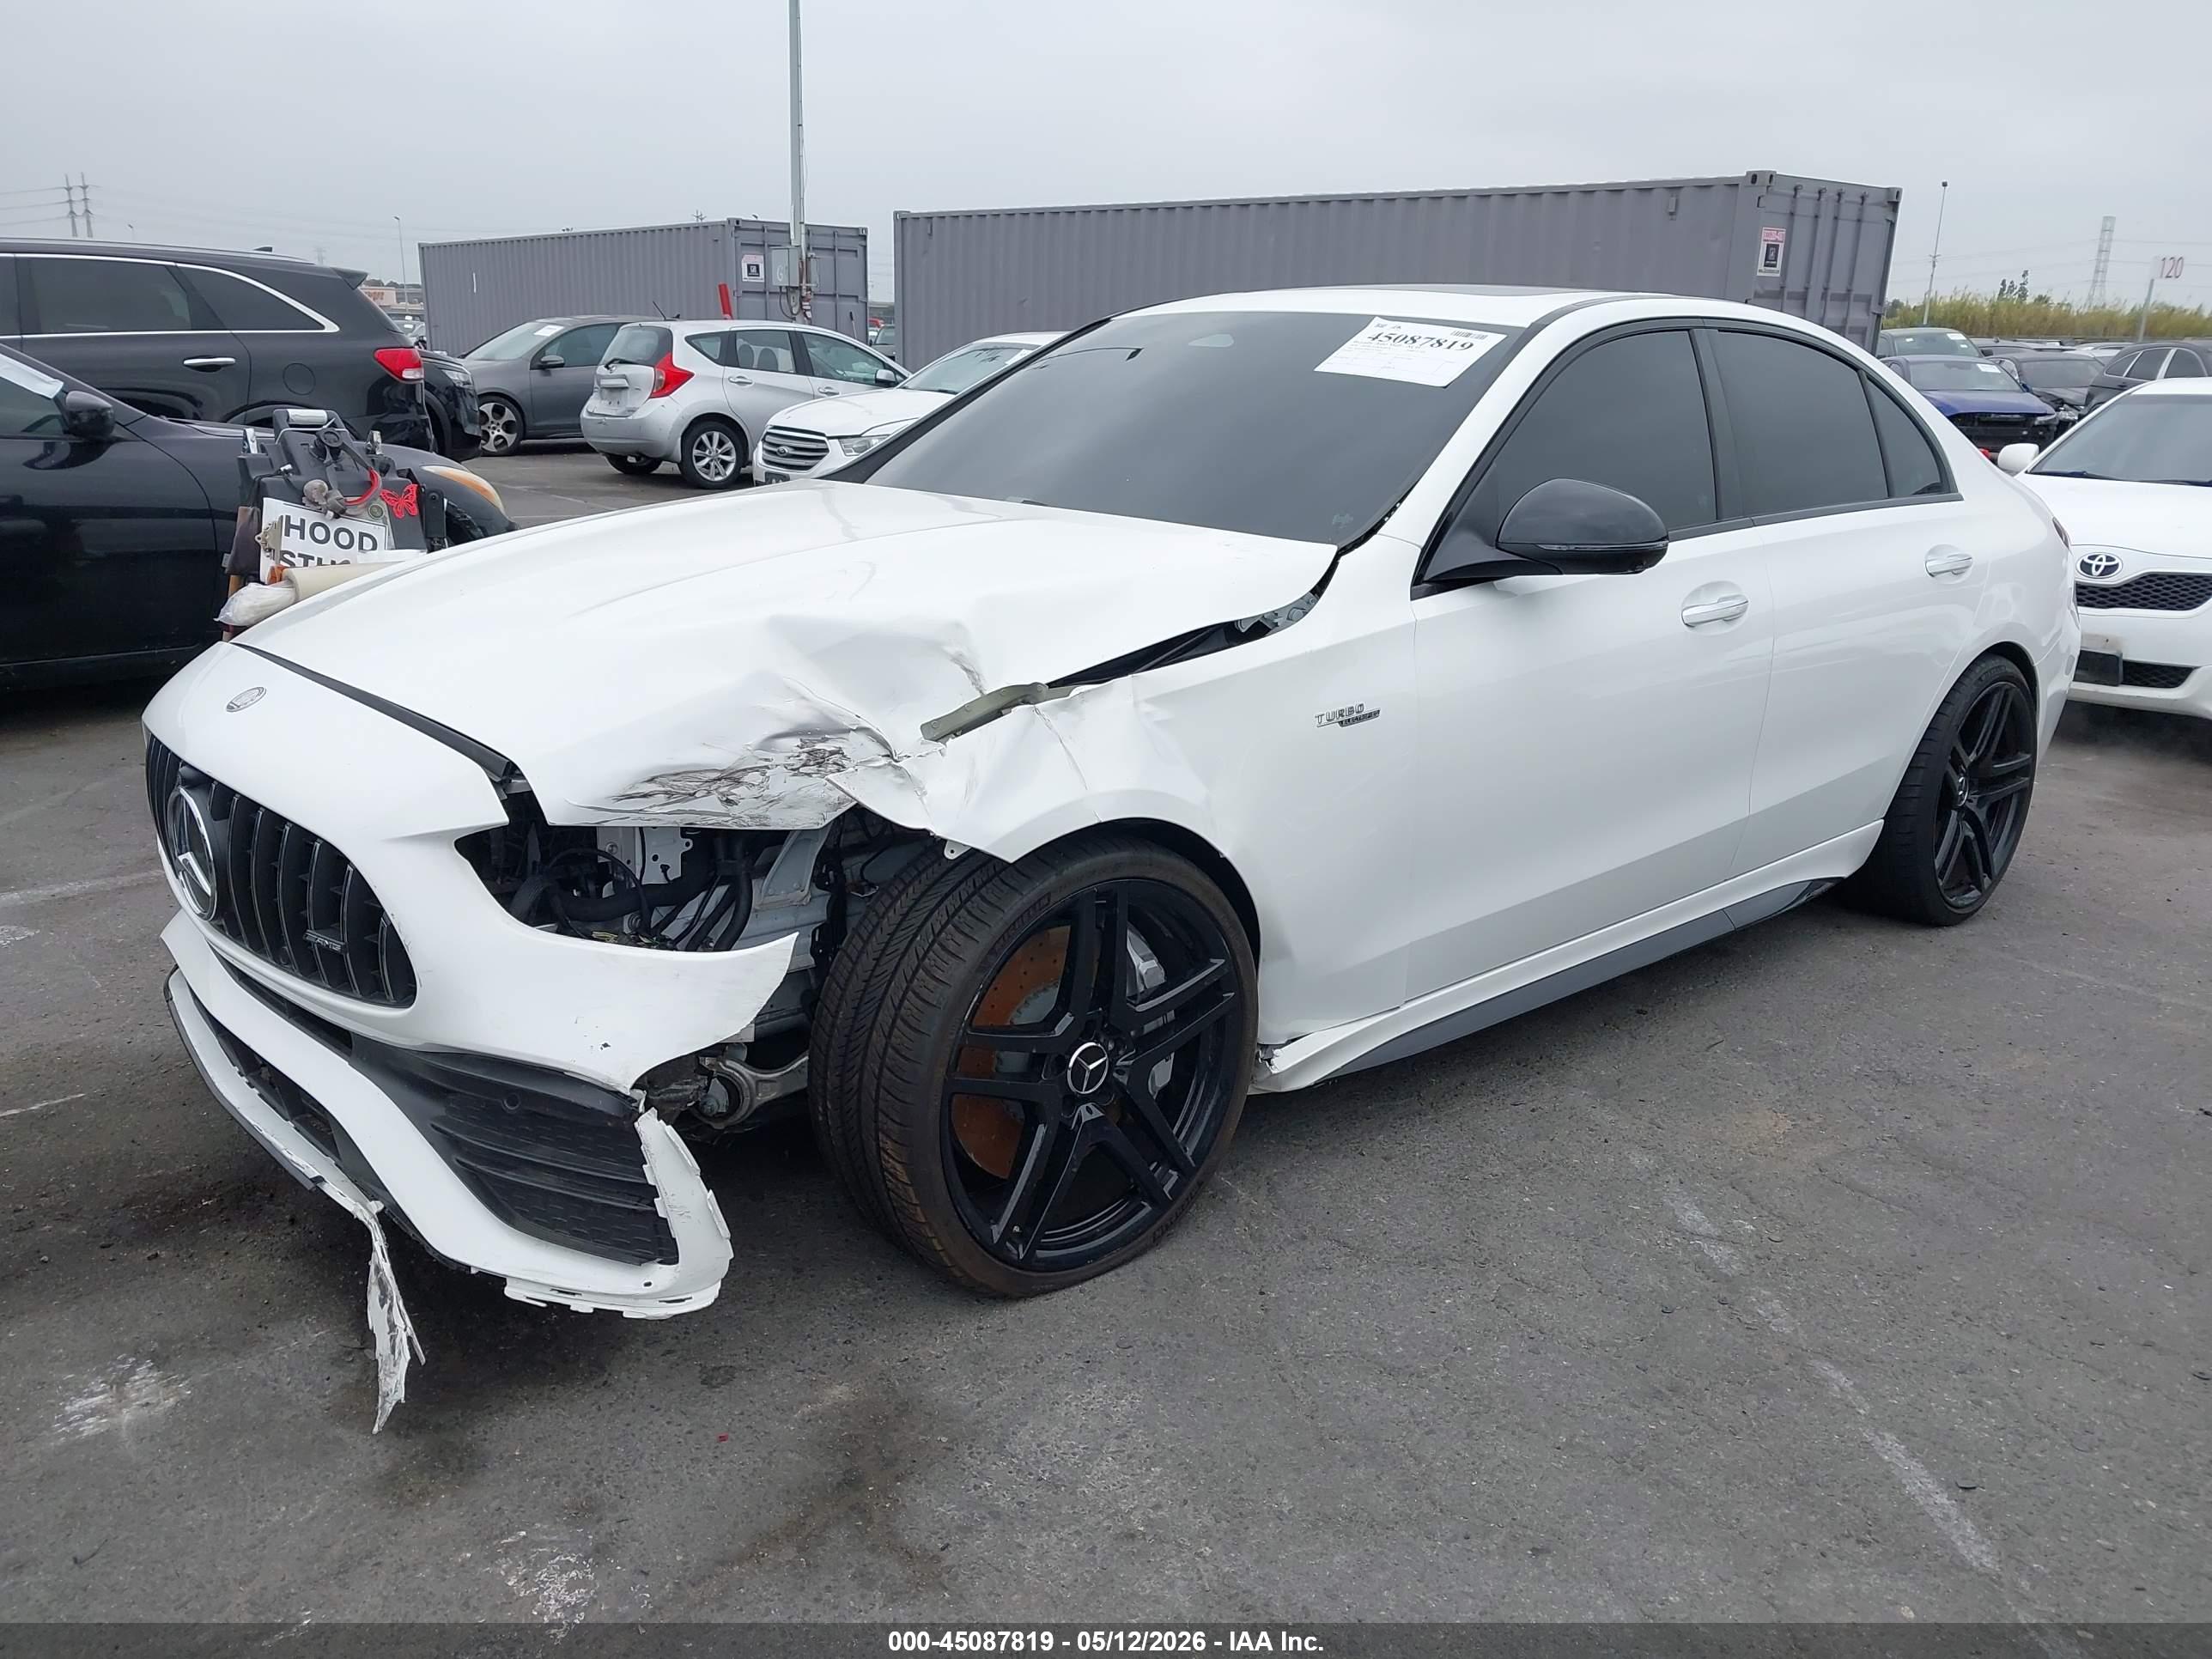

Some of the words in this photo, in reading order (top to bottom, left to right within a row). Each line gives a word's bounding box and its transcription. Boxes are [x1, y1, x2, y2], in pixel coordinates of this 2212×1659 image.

[2160, 257, 2185, 279] 120
[1367, 331, 1474, 351] 45087819
[284, 514, 378, 550] HOOD
[1315, 702, 1364, 725] TURBO
